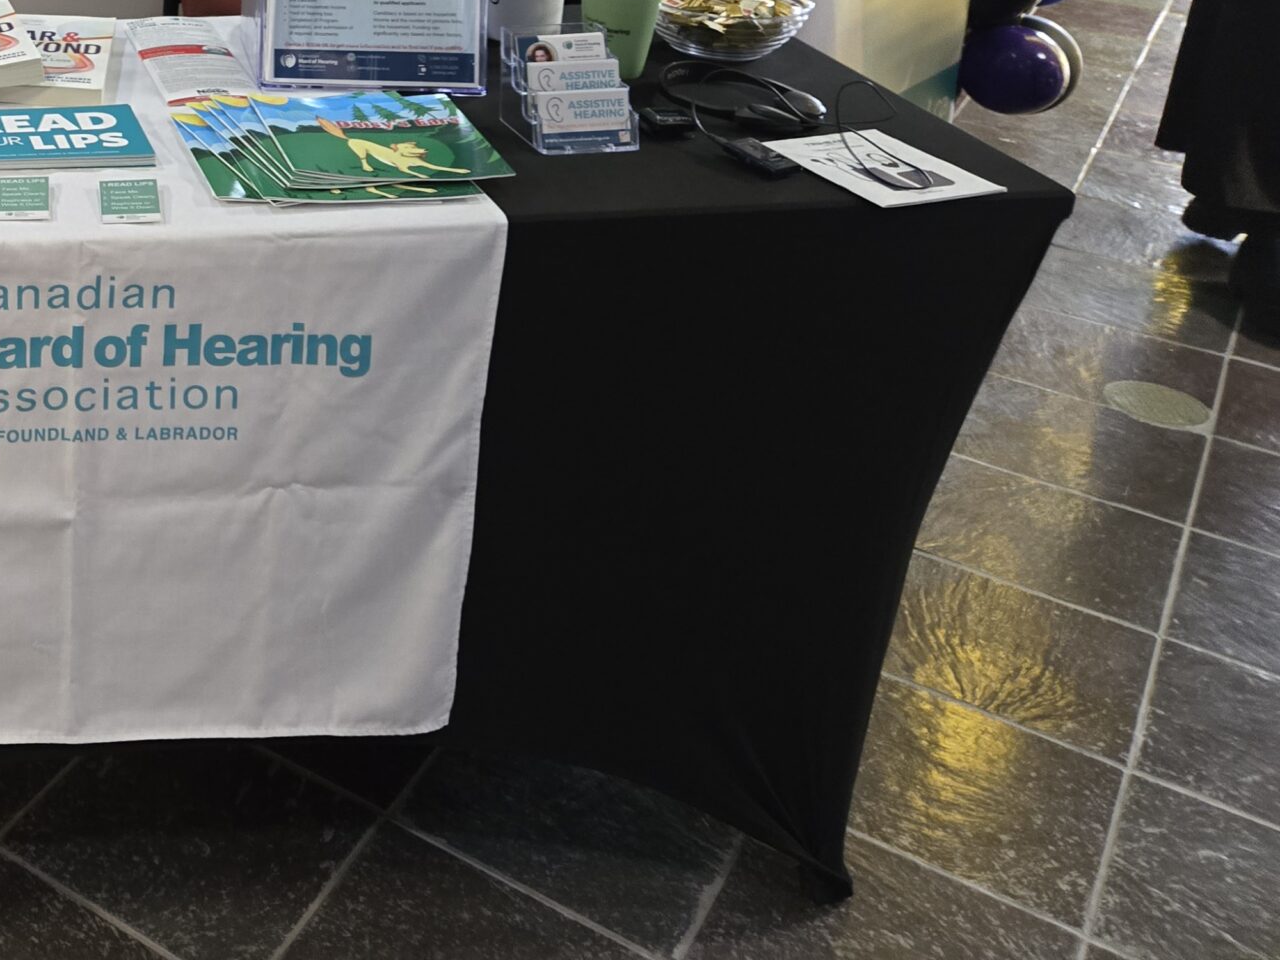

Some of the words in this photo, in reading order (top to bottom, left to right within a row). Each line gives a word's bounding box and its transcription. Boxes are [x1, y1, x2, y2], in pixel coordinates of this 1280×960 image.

[62, 31, 80, 42] &
[559, 69, 616, 80] ASSISTIVE
[565, 79, 617, 90] HEARING
[567, 98, 625, 109] ASSISTIVE
[573, 108, 625, 119] HEARING
[28, 132, 129, 150] LIPS
[93, 324, 148, 369] of
[162, 321, 373, 378] Hearing
[115, 427, 128, 440] &
[134, 425, 239, 442] LABRADOR
